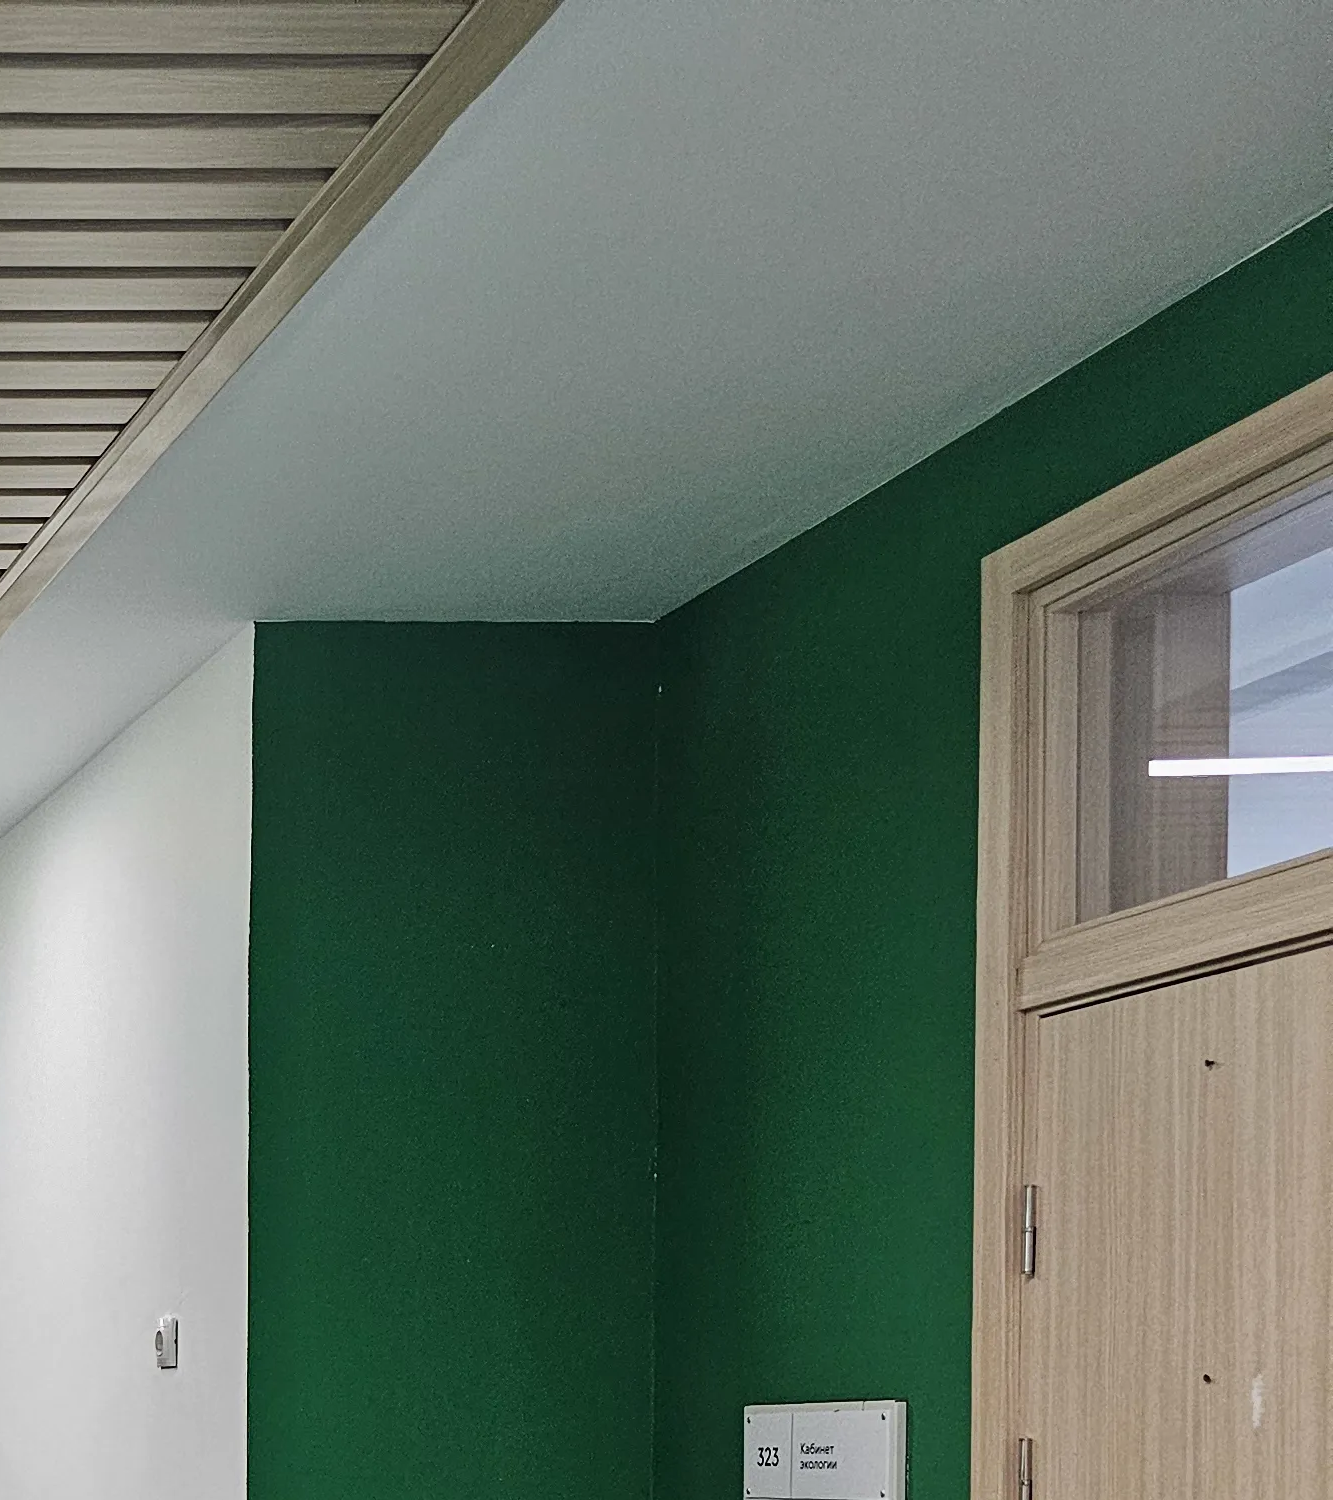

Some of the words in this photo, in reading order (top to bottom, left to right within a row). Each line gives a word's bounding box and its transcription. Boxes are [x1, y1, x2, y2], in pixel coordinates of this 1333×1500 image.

[800, 1443, 834, 1455] Кабинет
[757, 1446, 780, 1467] 323
[800, 1460, 837, 1470] экологии
